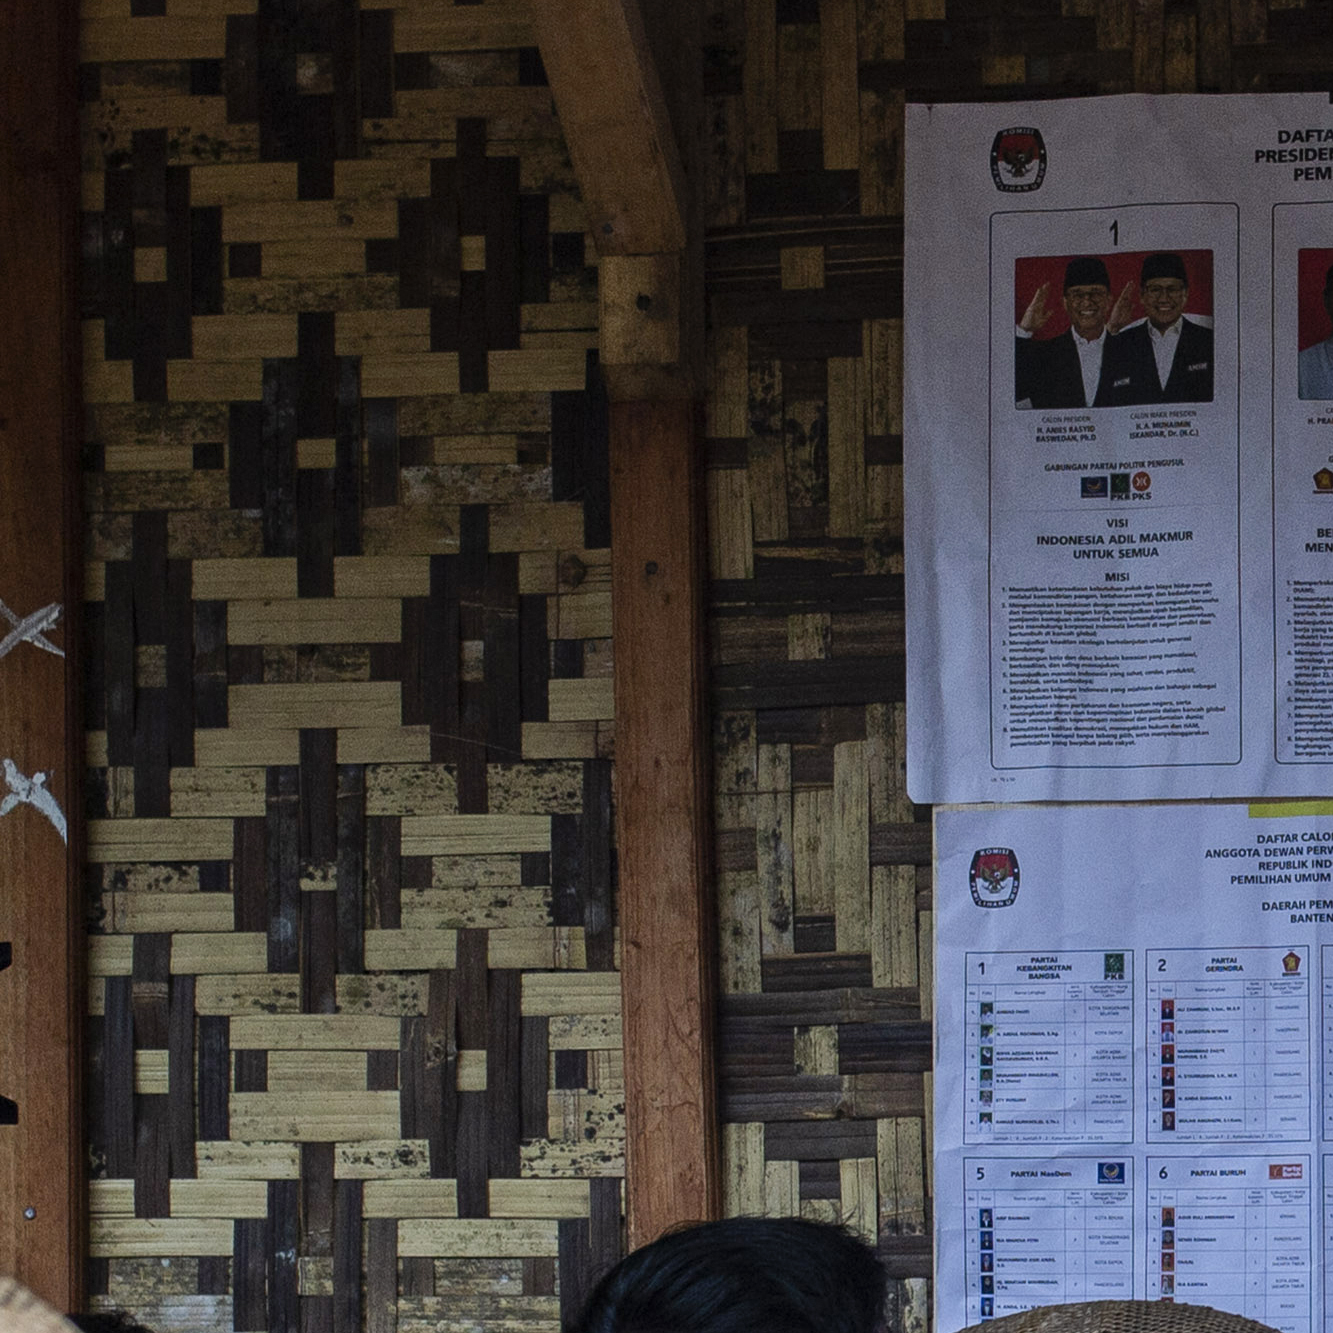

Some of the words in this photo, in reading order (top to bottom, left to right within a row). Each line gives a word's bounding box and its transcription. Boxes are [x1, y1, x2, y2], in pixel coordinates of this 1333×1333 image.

[1109, 220, 1118, 246] 1
[1132, 492, 1152, 501] PKS
[1106, 518, 1128, 528] VISI
[1036, 535, 1105, 546] INDONESIA
[1108, 534, 1136, 544] ADIL
[1139, 531, 1193, 543] MAKMUR
[1073, 549, 1114, 559] UNTUK
[1118, 547, 1159, 559] SEMUA
[1105, 572, 1129, 582] MISI
[1257, 833, 1298, 844] DAFTAR
[1205, 848, 1261, 858] ANGGOTA
[1264, 847, 1304, 857] DEWAN
[1258, 860, 1308, 871] REPUBLIK
[1231, 874, 1292, 884] PEMILIHAN
[1294, 872, 1331, 883] UMUM
[1262, 901, 1306, 911] DAERAH
[978, 962, 985, 975] 1
[1158, 958, 1166, 972] 2
[976, 1167, 985, 1180] 5
[1159, 1166, 1168, 1180] 6
